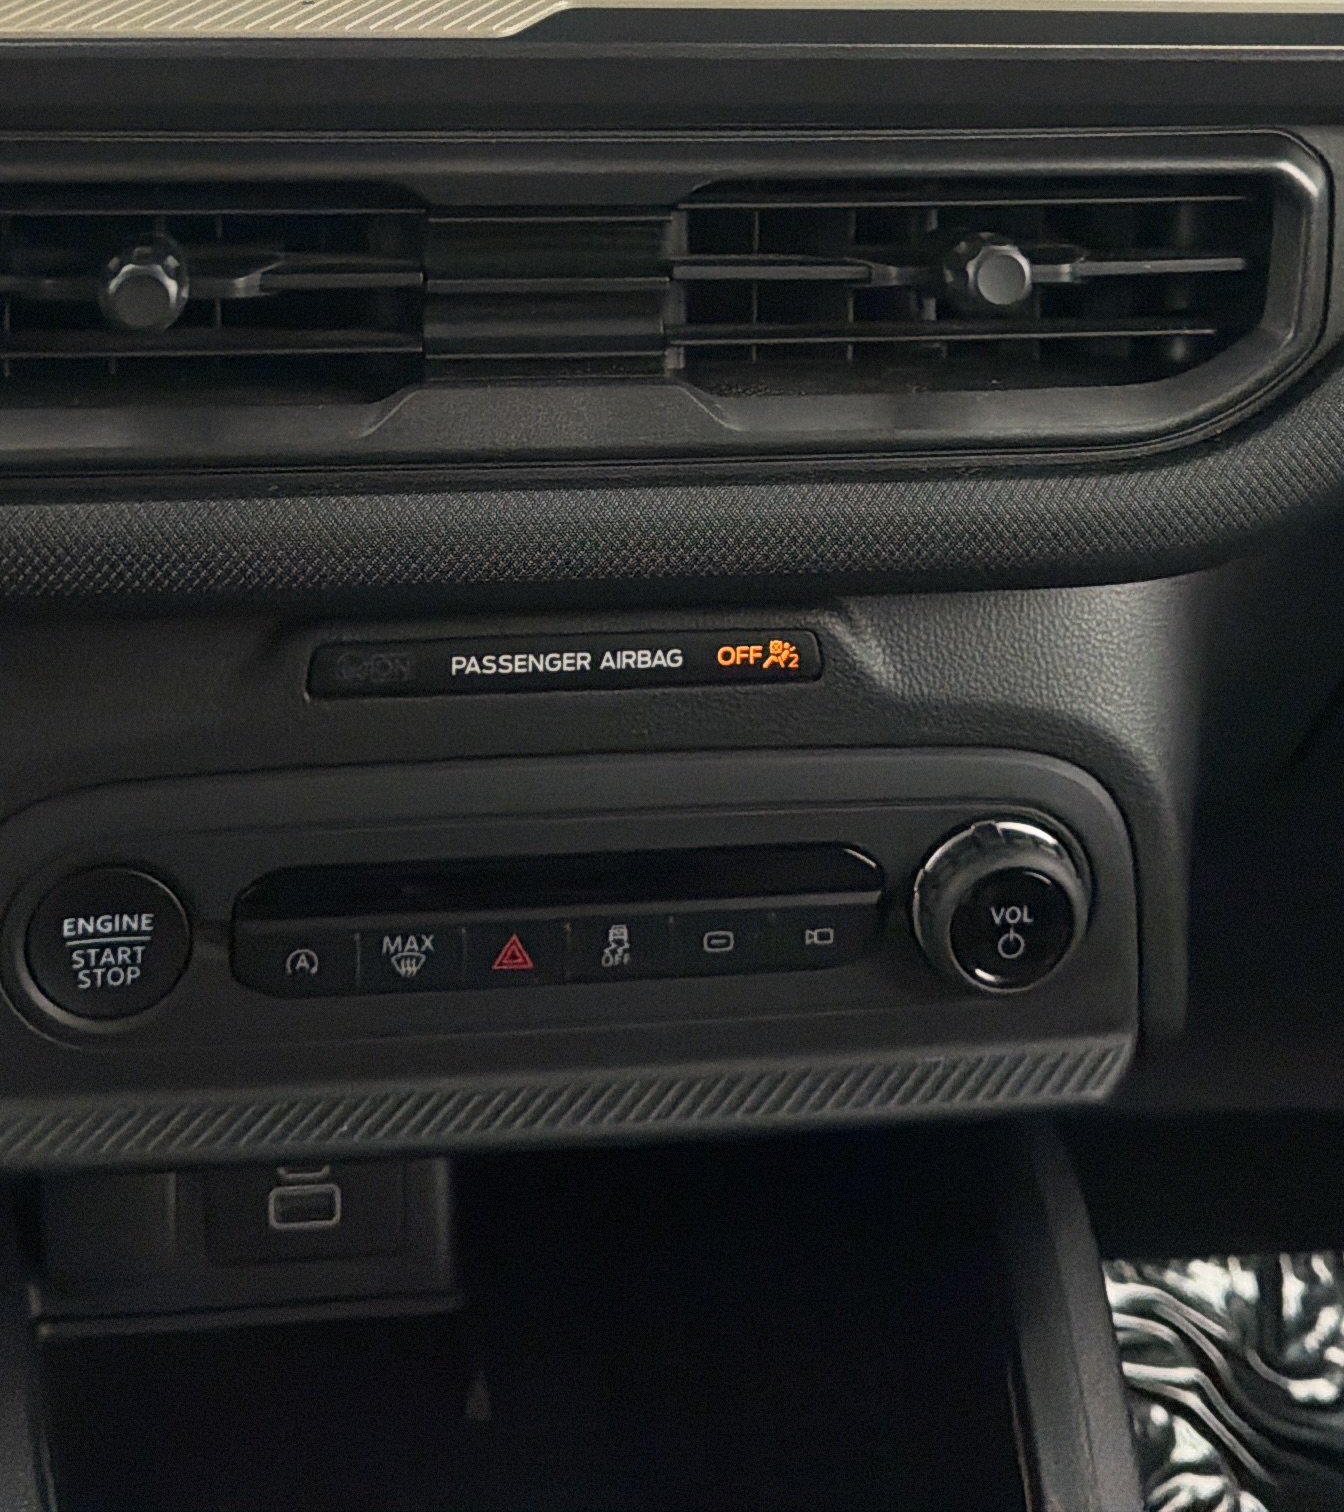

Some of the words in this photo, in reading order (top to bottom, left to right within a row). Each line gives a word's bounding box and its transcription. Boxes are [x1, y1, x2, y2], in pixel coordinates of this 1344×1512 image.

[451, 651, 592, 676] PASSENGER
[598, 648, 684, 671] AIRBAG
[716, 645, 763, 667] OFF
[62, 913, 154, 937] ENGINE
[989, 904, 1034, 925] VOL
[381, 934, 435, 955] MAX
[71, 945, 146, 969] START
[601, 951, 631, 968] OFF
[77, 966, 141, 989] STOP
